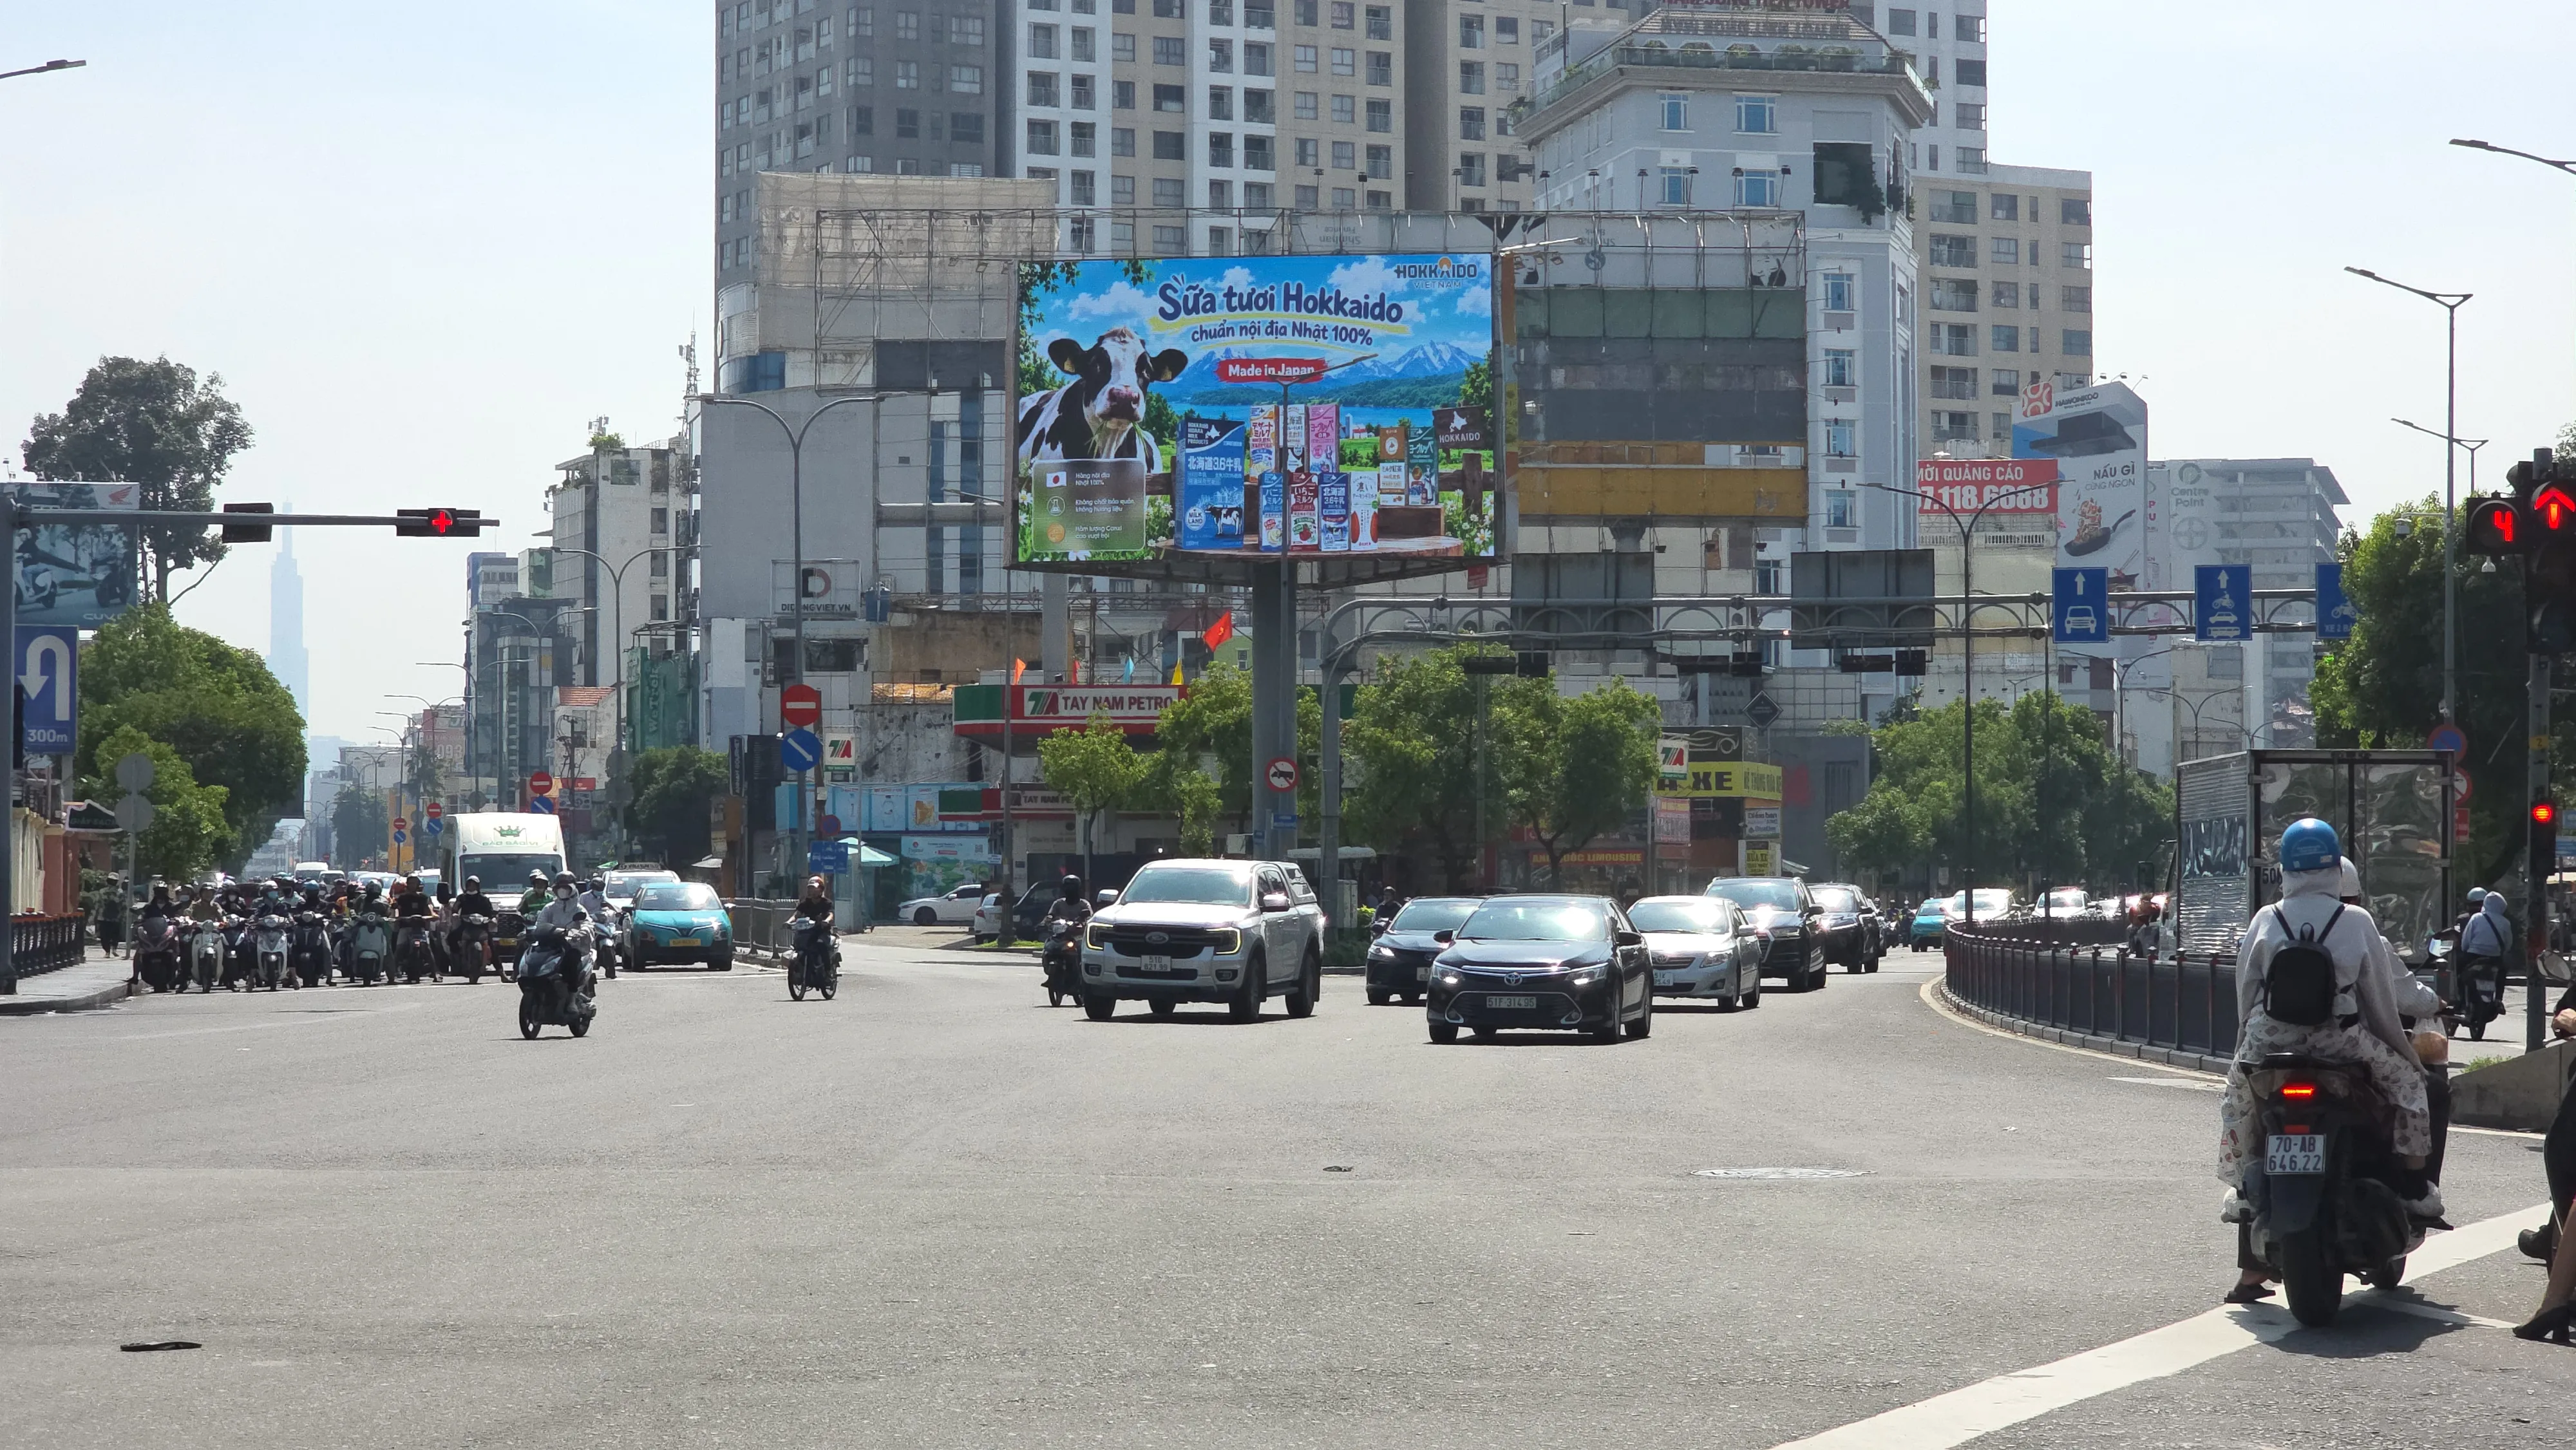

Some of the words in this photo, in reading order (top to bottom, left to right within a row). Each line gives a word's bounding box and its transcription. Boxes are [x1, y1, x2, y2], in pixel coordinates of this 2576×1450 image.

[1394, 264, 1477, 279] HOKKAIDO
[1159, 282, 1217, 321] Sữa
[1223, 284, 1276, 313] tươi
[1283, 281, 1403, 323] Hokkaido
[1191, 319, 1235, 343] chuẩn
[1239, 320, 1261, 340] nội
[1264, 320, 1287, 341] địa
[1291, 321, 1328, 341] Nhật
[1332, 326, 1373, 346] 100%
[1228, 364, 1260, 377] Made
[1264, 364, 1275, 376] in
[1278, 363, 1315, 377] Japan
[1439, 432, 1481, 444] HOKKAIDO
[1944, 463, 1991, 482] QUẢNG
[1996, 463, 2024, 481] CÁO
[2094, 463, 2117, 480] NẤU
[2121, 461, 2136, 476] GÌ
[2108, 478, 2136, 489] NGON
[2170, 487, 2210, 497] Centre
[2175, 498, 2205, 507] Point
[2494, 511, 2513, 541] 4
[781, 603, 851, 612] DIDNGVIET.VN
[1063, 696, 1088, 711] TAY
[1093, 696, 1125, 710] NAM
[1128, 696, 1173, 710] PETRO
[28, 729, 68, 742] 300m
[1692, 771, 1733, 791] XE
[1587, 853, 1642, 862] LIMOUSINE
[2275, 1136, 2316, 1153] 70-AB
[2269, 1154, 2321, 1171] 646.22
